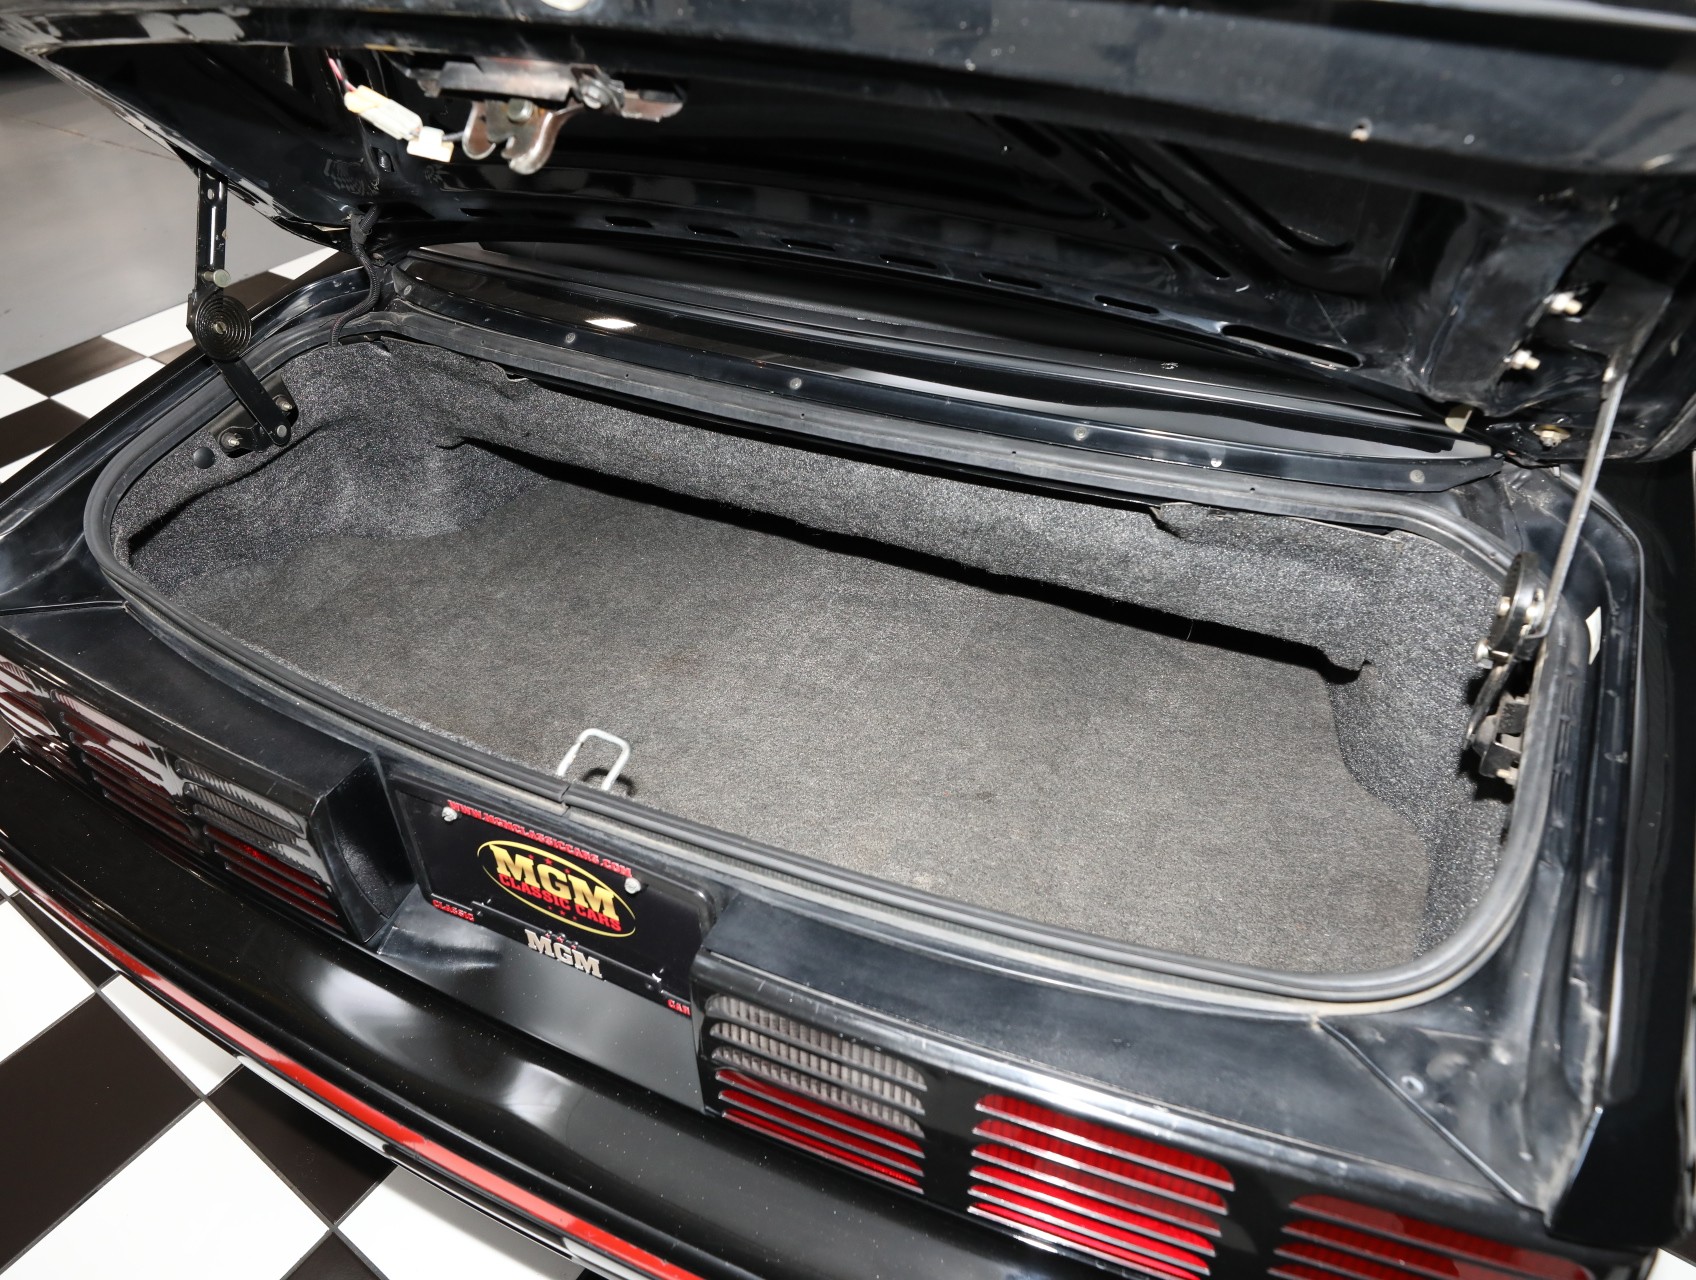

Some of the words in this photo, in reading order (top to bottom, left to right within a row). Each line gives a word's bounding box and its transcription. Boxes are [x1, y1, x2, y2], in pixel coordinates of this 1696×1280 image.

[489, 844, 620, 921] MGM
[498, 873, 571, 911] CLASSIC
[574, 903, 622, 932] CARS
[524, 928, 603, 979] MGM
